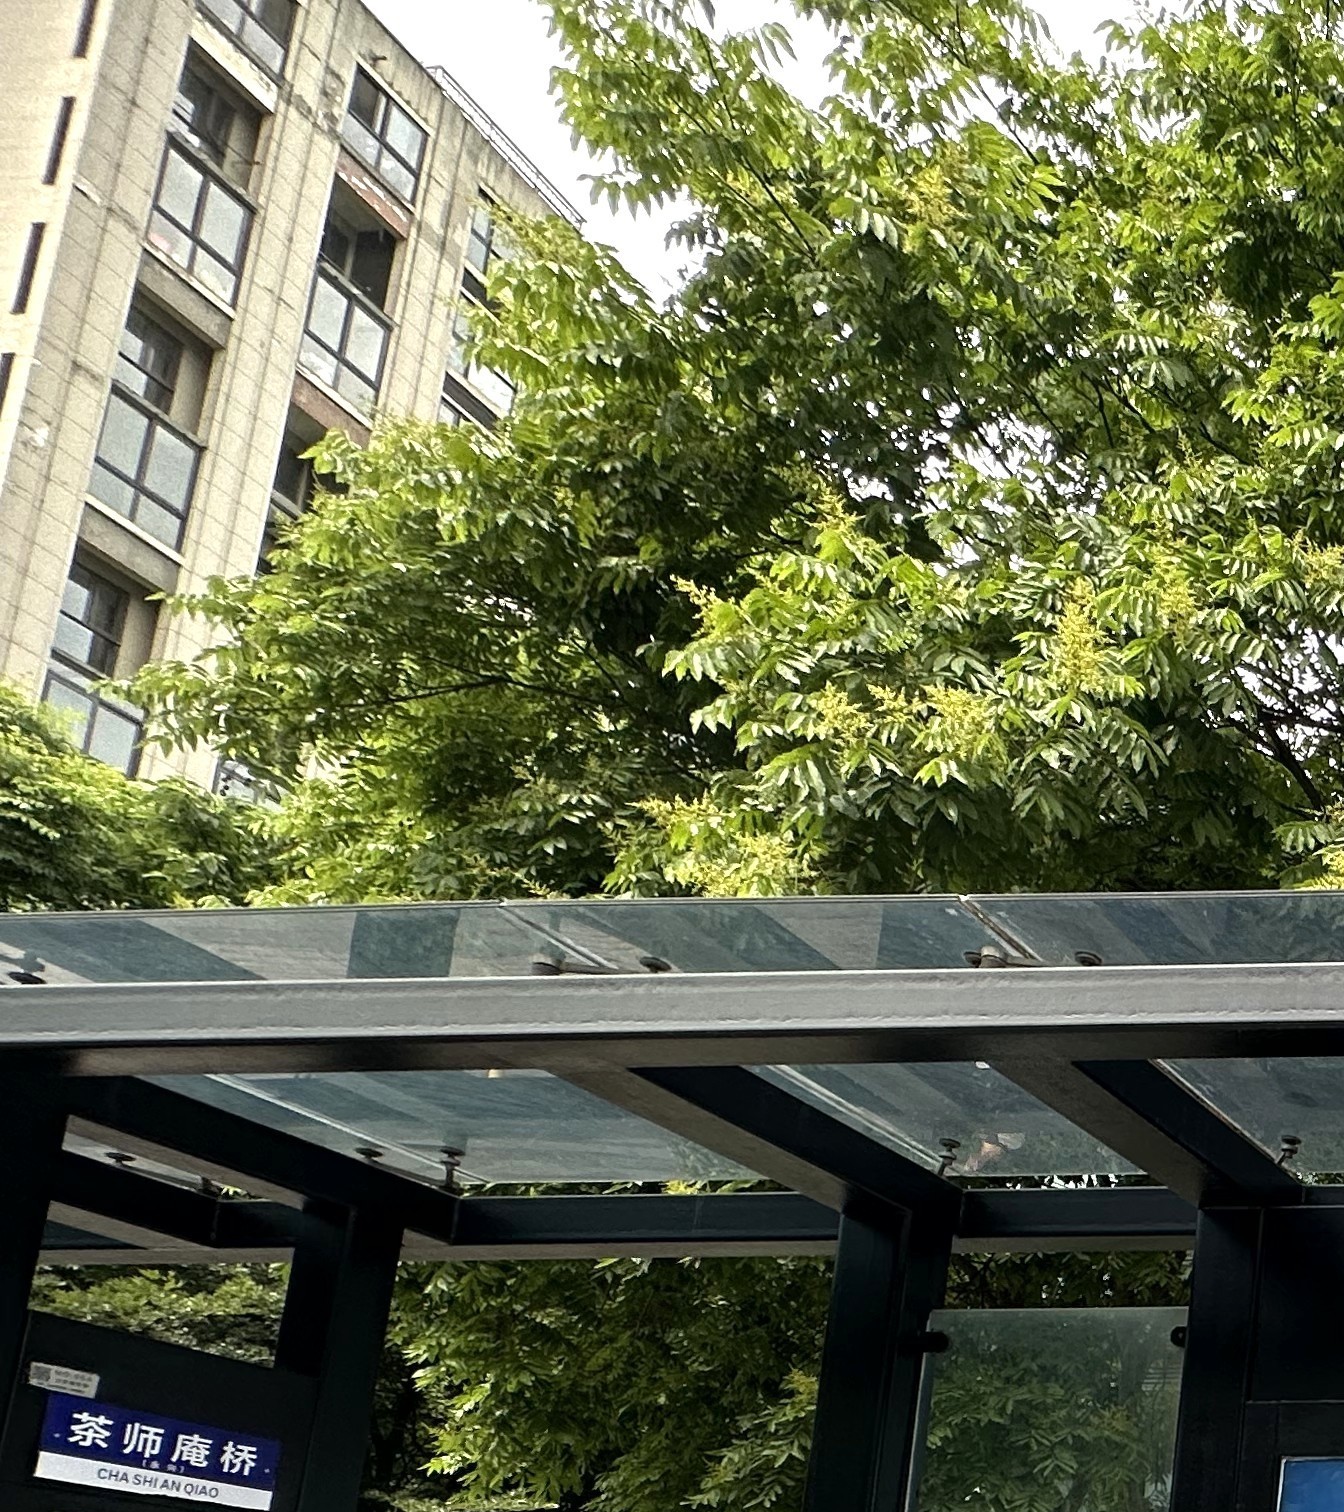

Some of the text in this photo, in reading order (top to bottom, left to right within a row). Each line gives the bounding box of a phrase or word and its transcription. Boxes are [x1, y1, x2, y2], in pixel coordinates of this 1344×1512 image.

[67, 1411, 258, 1476] 茶师庵桥
[96, 1467, 220, 1499] CHA SHI AN QIAO
